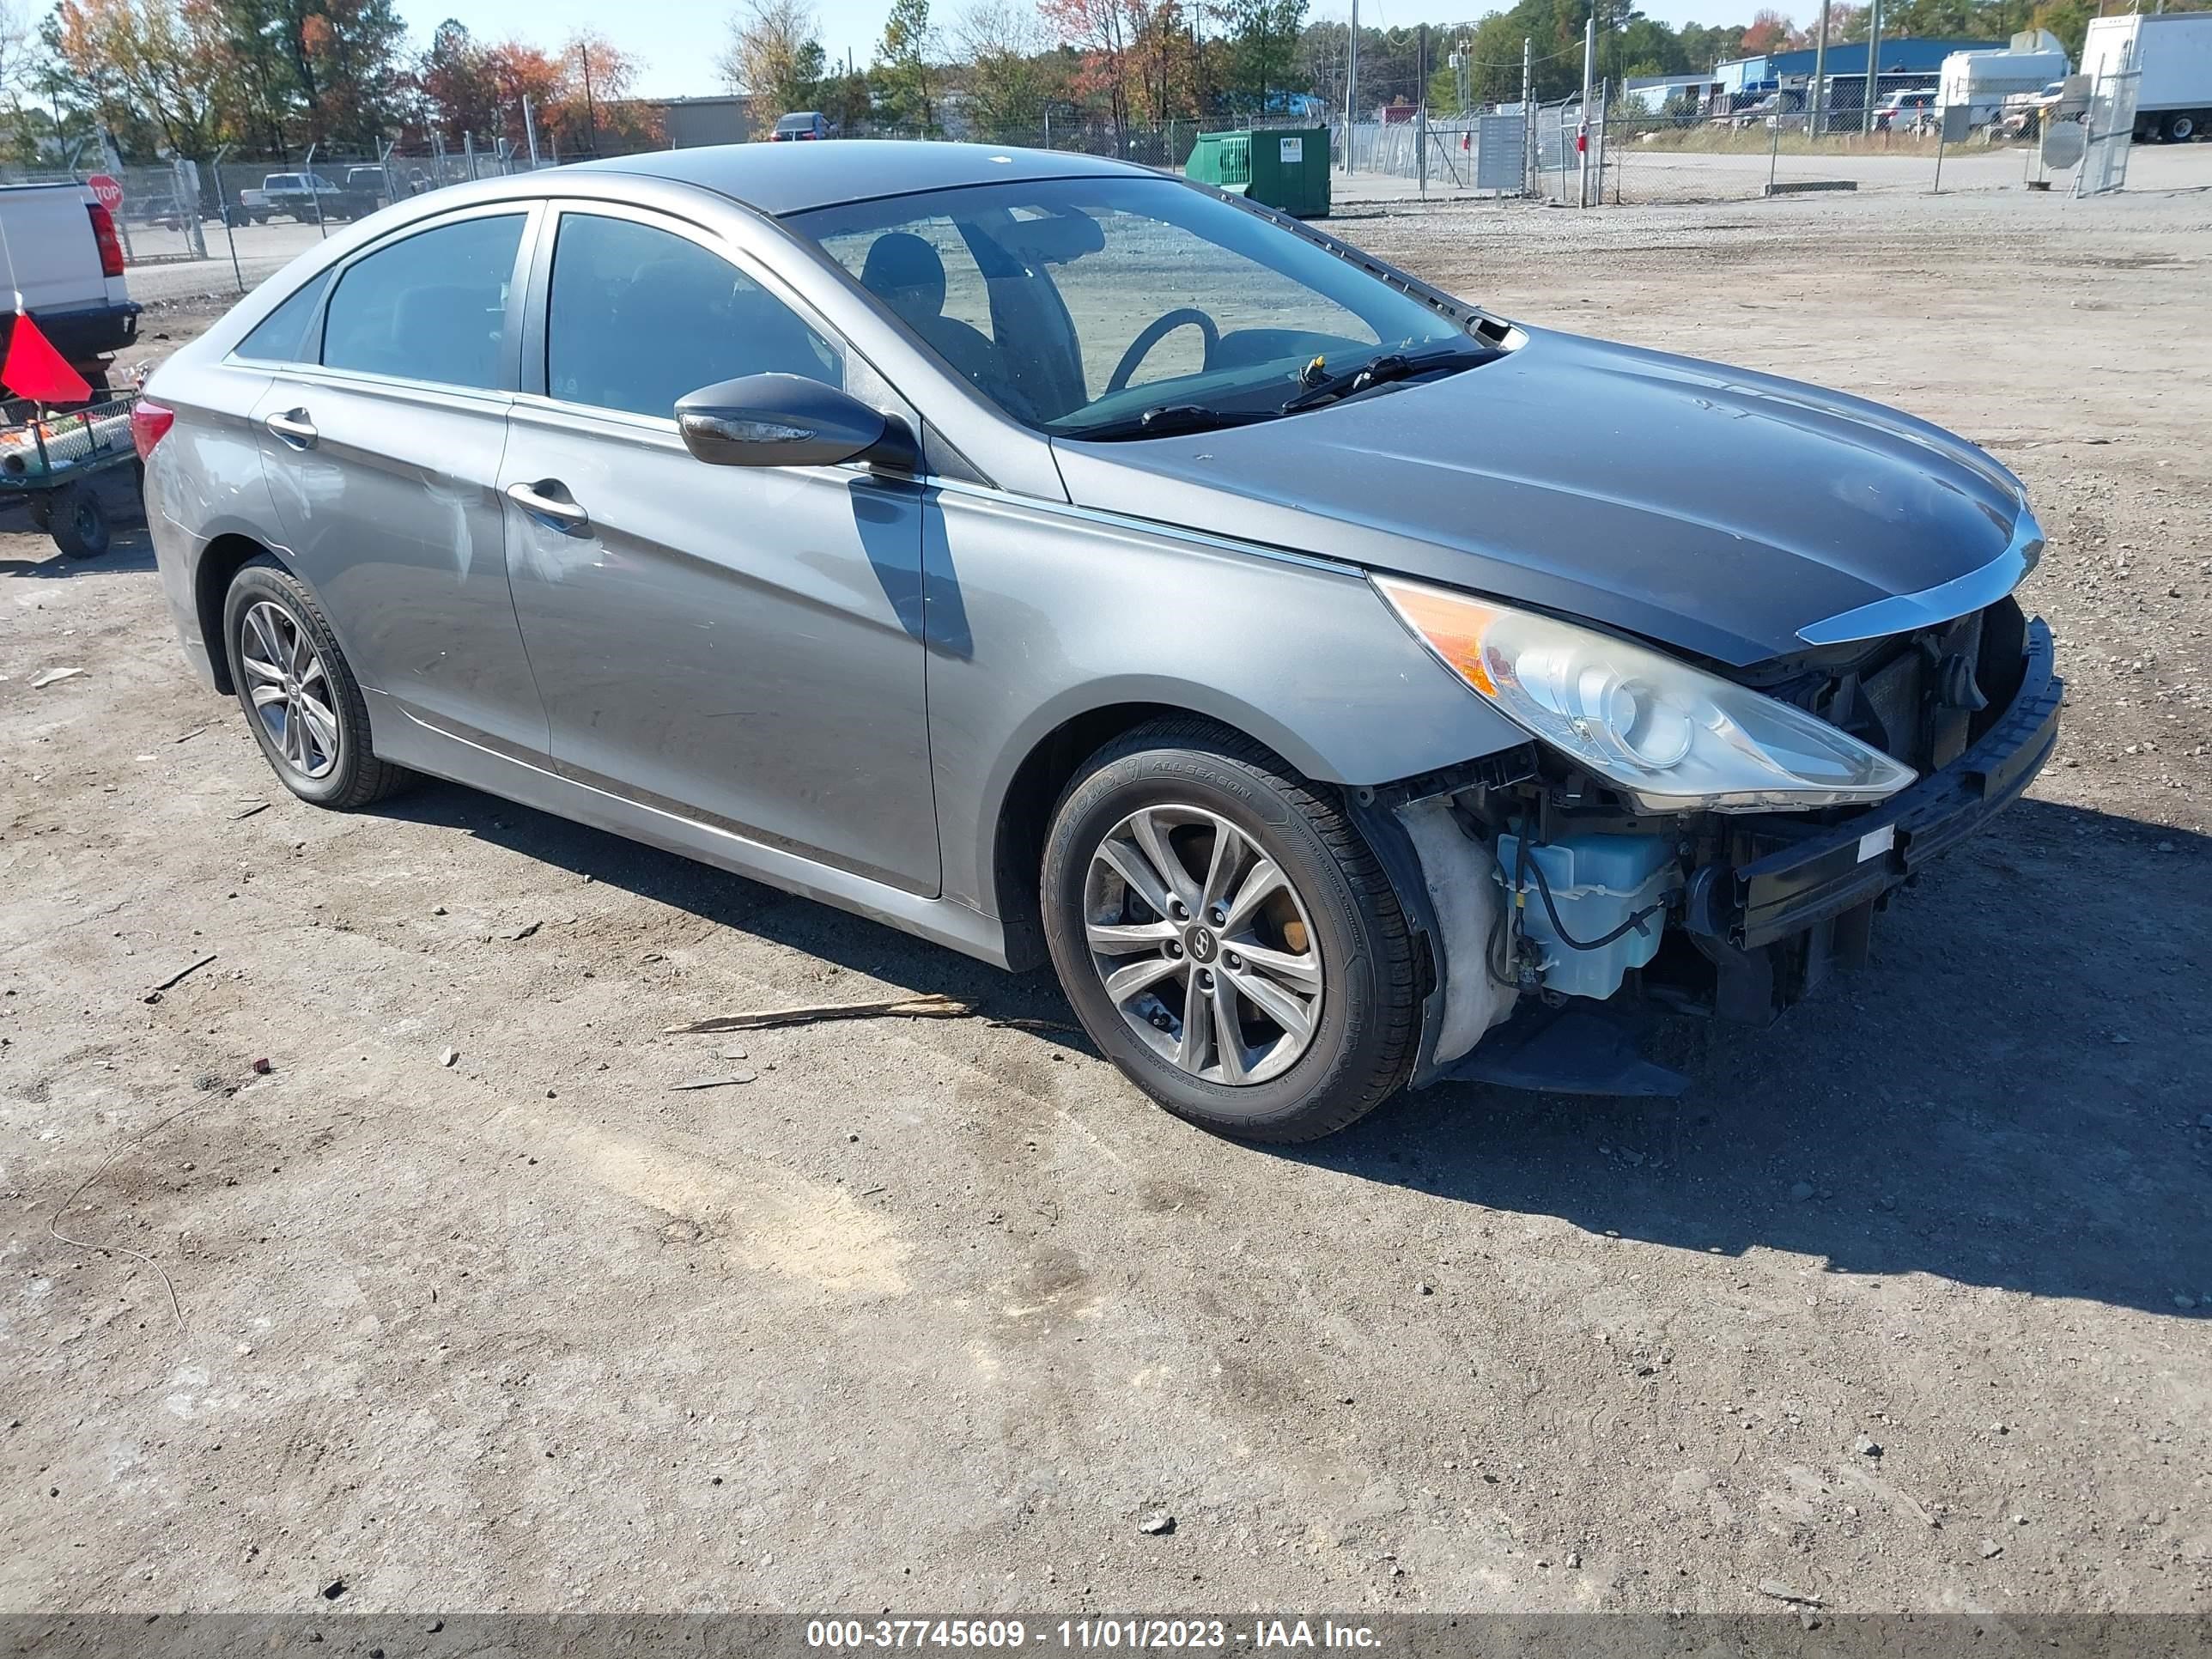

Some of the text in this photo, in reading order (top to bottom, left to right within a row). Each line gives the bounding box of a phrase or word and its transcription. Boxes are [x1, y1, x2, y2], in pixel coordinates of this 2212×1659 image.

[94, 185, 119, 201] TOP
[1152, 761, 1253, 800] ALL SEASON
